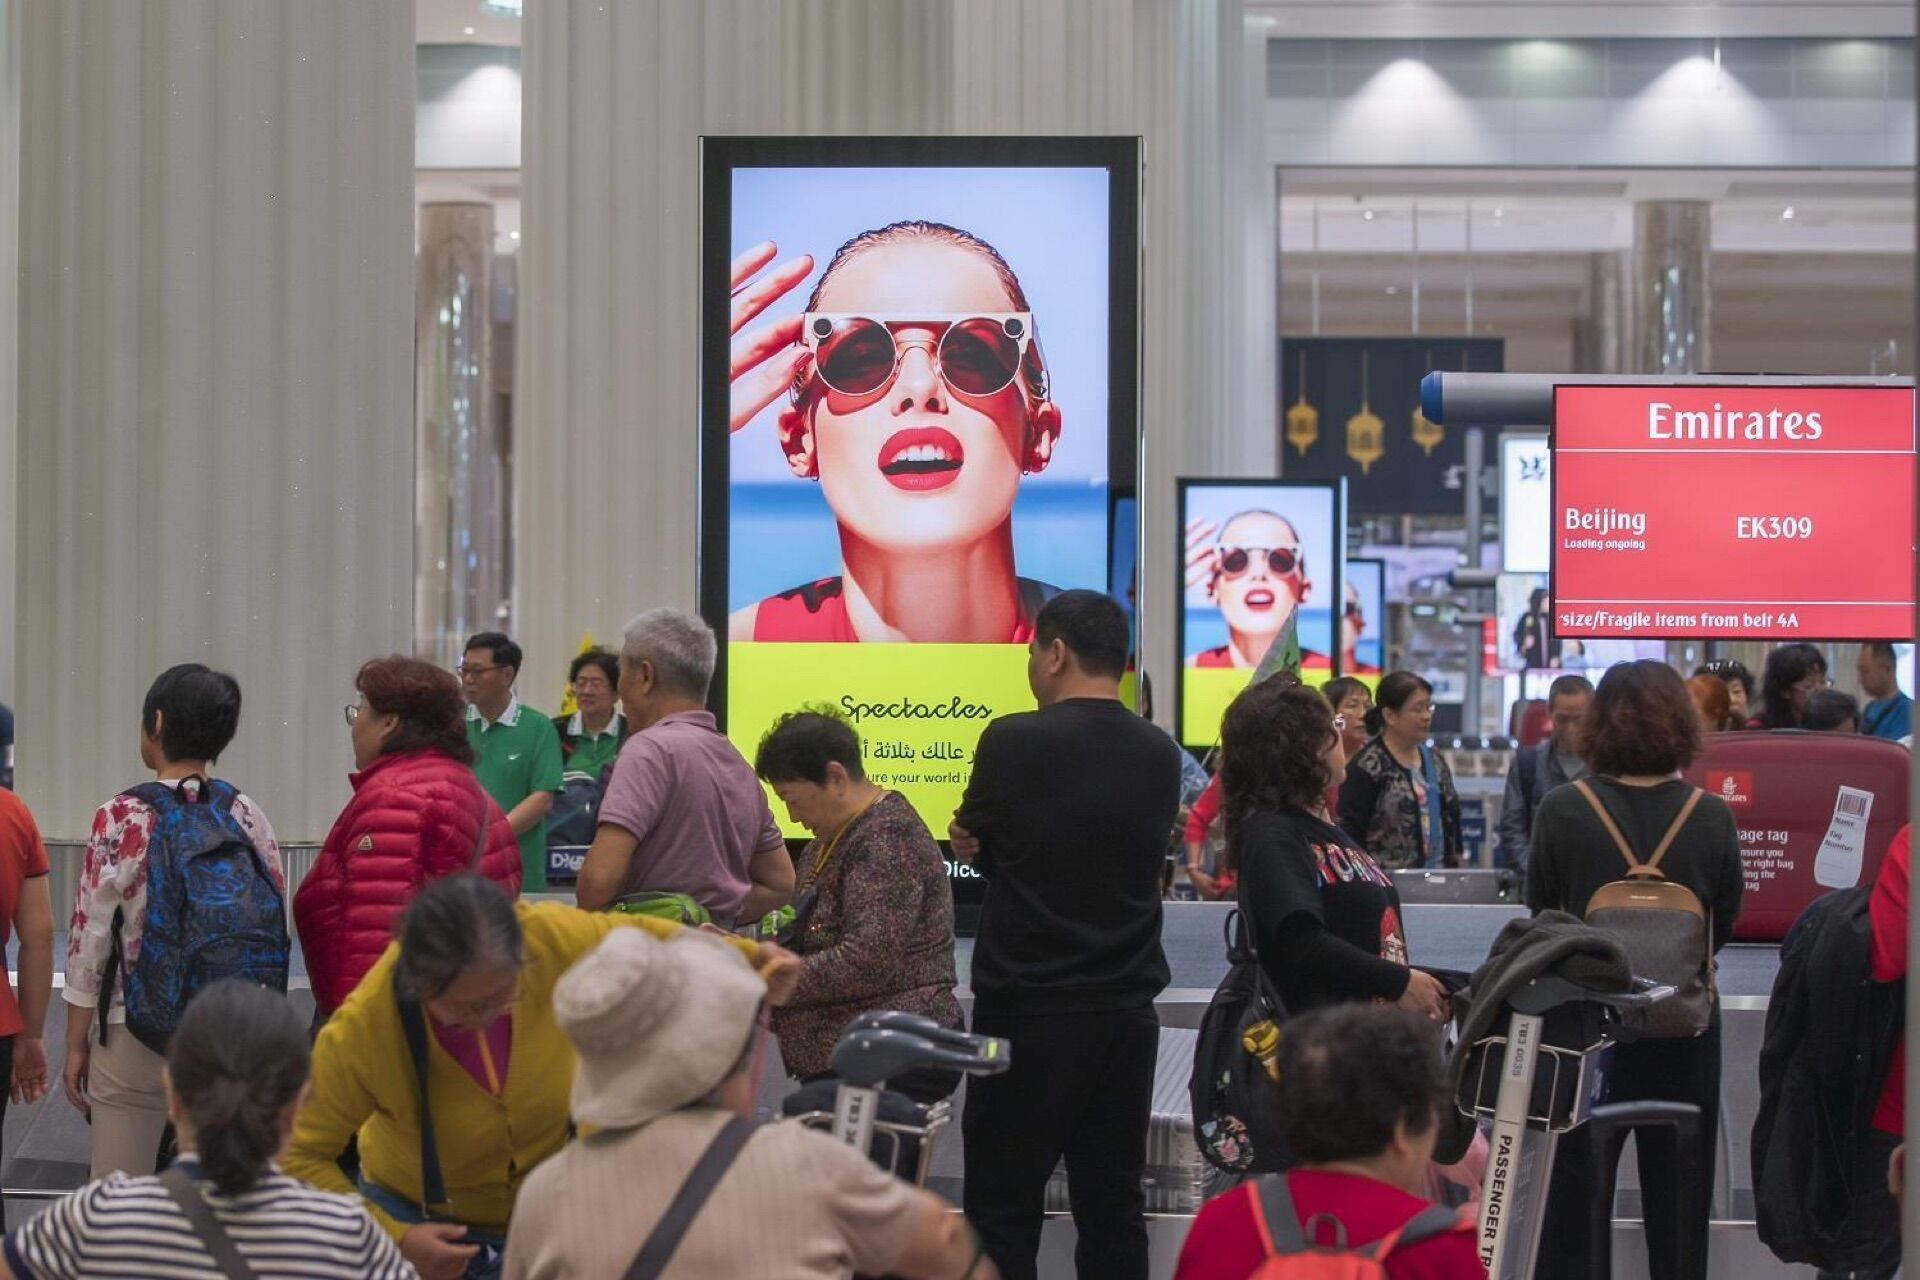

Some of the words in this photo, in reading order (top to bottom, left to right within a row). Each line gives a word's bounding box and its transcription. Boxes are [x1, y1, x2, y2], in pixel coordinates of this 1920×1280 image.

[1648, 402, 1823, 440] Emirates
[1565, 508, 1646, 535] Beijing
[1737, 516, 1813, 539] EK309
[1564, 538, 1603, 550] Loading
[1605, 538, 1646, 551] ongoing
[1559, 611, 1651, 630] size/Fragile
[1655, 612, 1697, 627] items
[1701, 612, 1739, 628] from
[1743, 612, 1773, 628] belt
[1776, 613, 1799, 628] 4A
[841, 694, 993, 723] Spectacles
[891, 773, 920, 785] your
[924, 772, 960, 783] world
[1736, 830, 1764, 844] age
[1767, 830, 1788, 845] tag
[1740, 848, 1765, 857] nsure
[1766, 849, 1784, 859] you
[1753, 858, 1775, 870] right
[1761, 870, 1776, 879] the
[1484, 1134, 1512, 1240] PASSENGER
